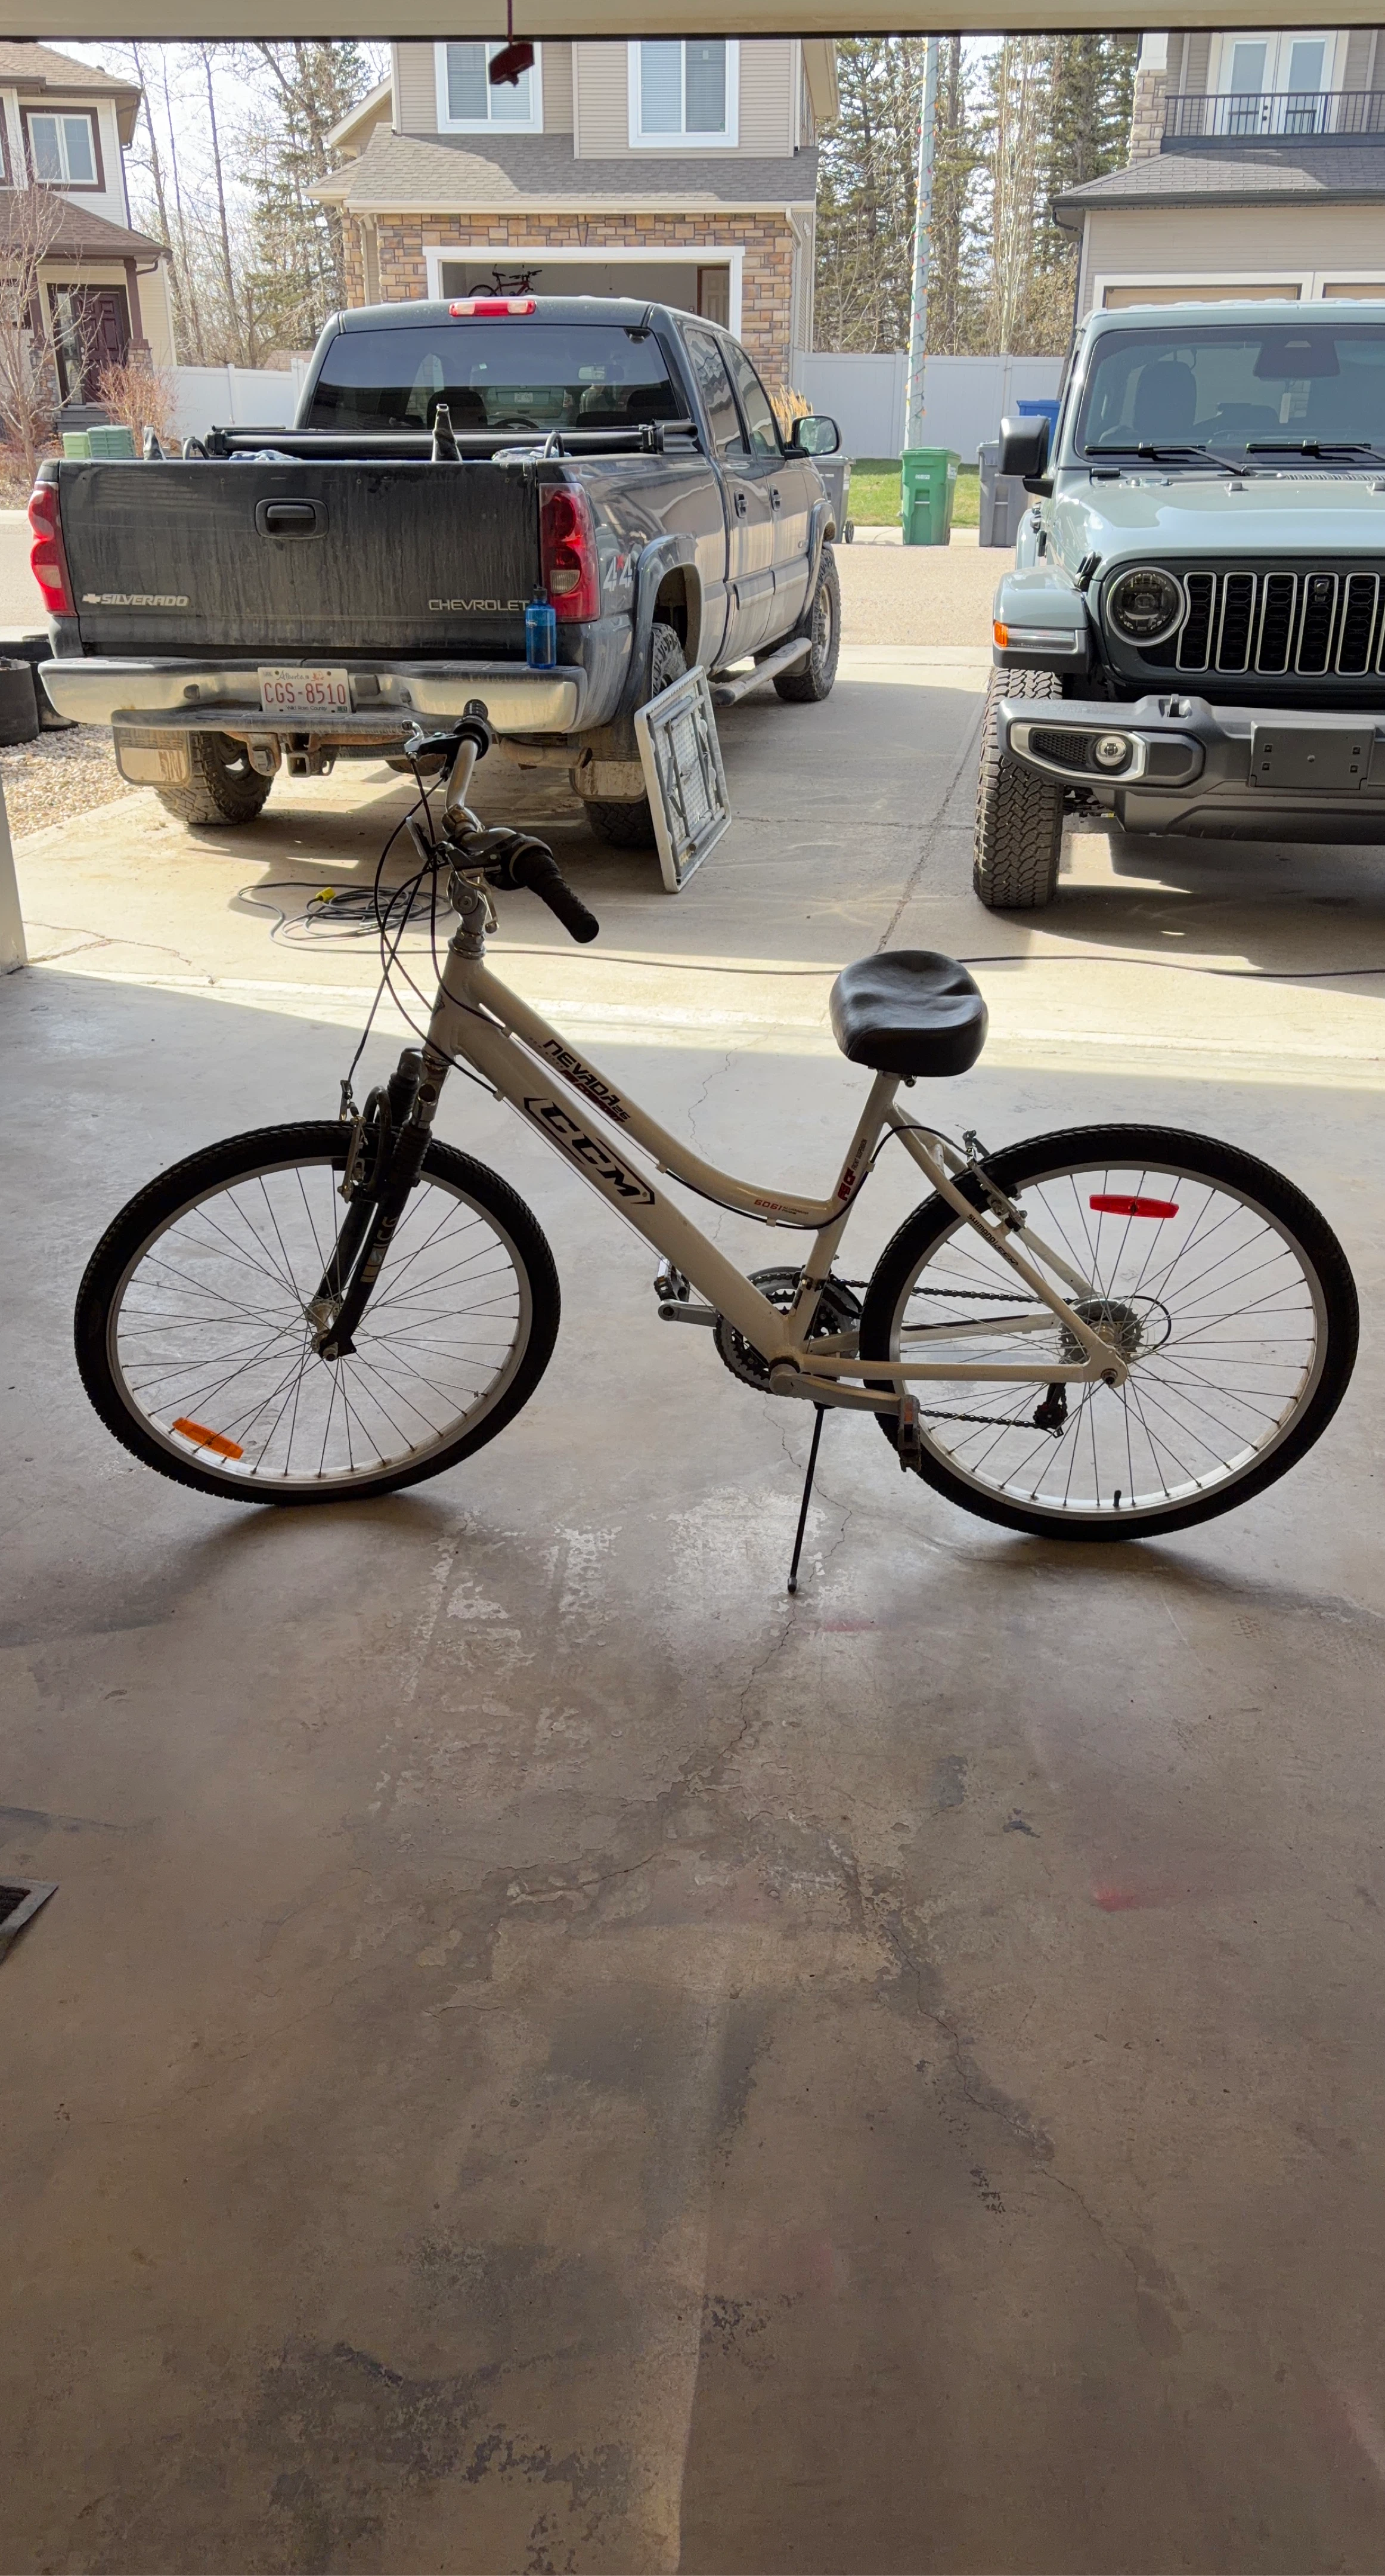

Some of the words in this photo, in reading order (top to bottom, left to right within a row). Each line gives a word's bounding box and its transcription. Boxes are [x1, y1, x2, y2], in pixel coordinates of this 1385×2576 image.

[100, 593, 190, 606] SILVERADO
[429, 599, 531, 611] CHEVROLET
[276, 670, 305, 680] Alberta
[264, 682, 347, 705] CGS-8510
[540, 1101, 642, 1197] CCM
[754, 1199, 783, 1211] 6061
[967, 1213, 996, 1243] SHIMANO
